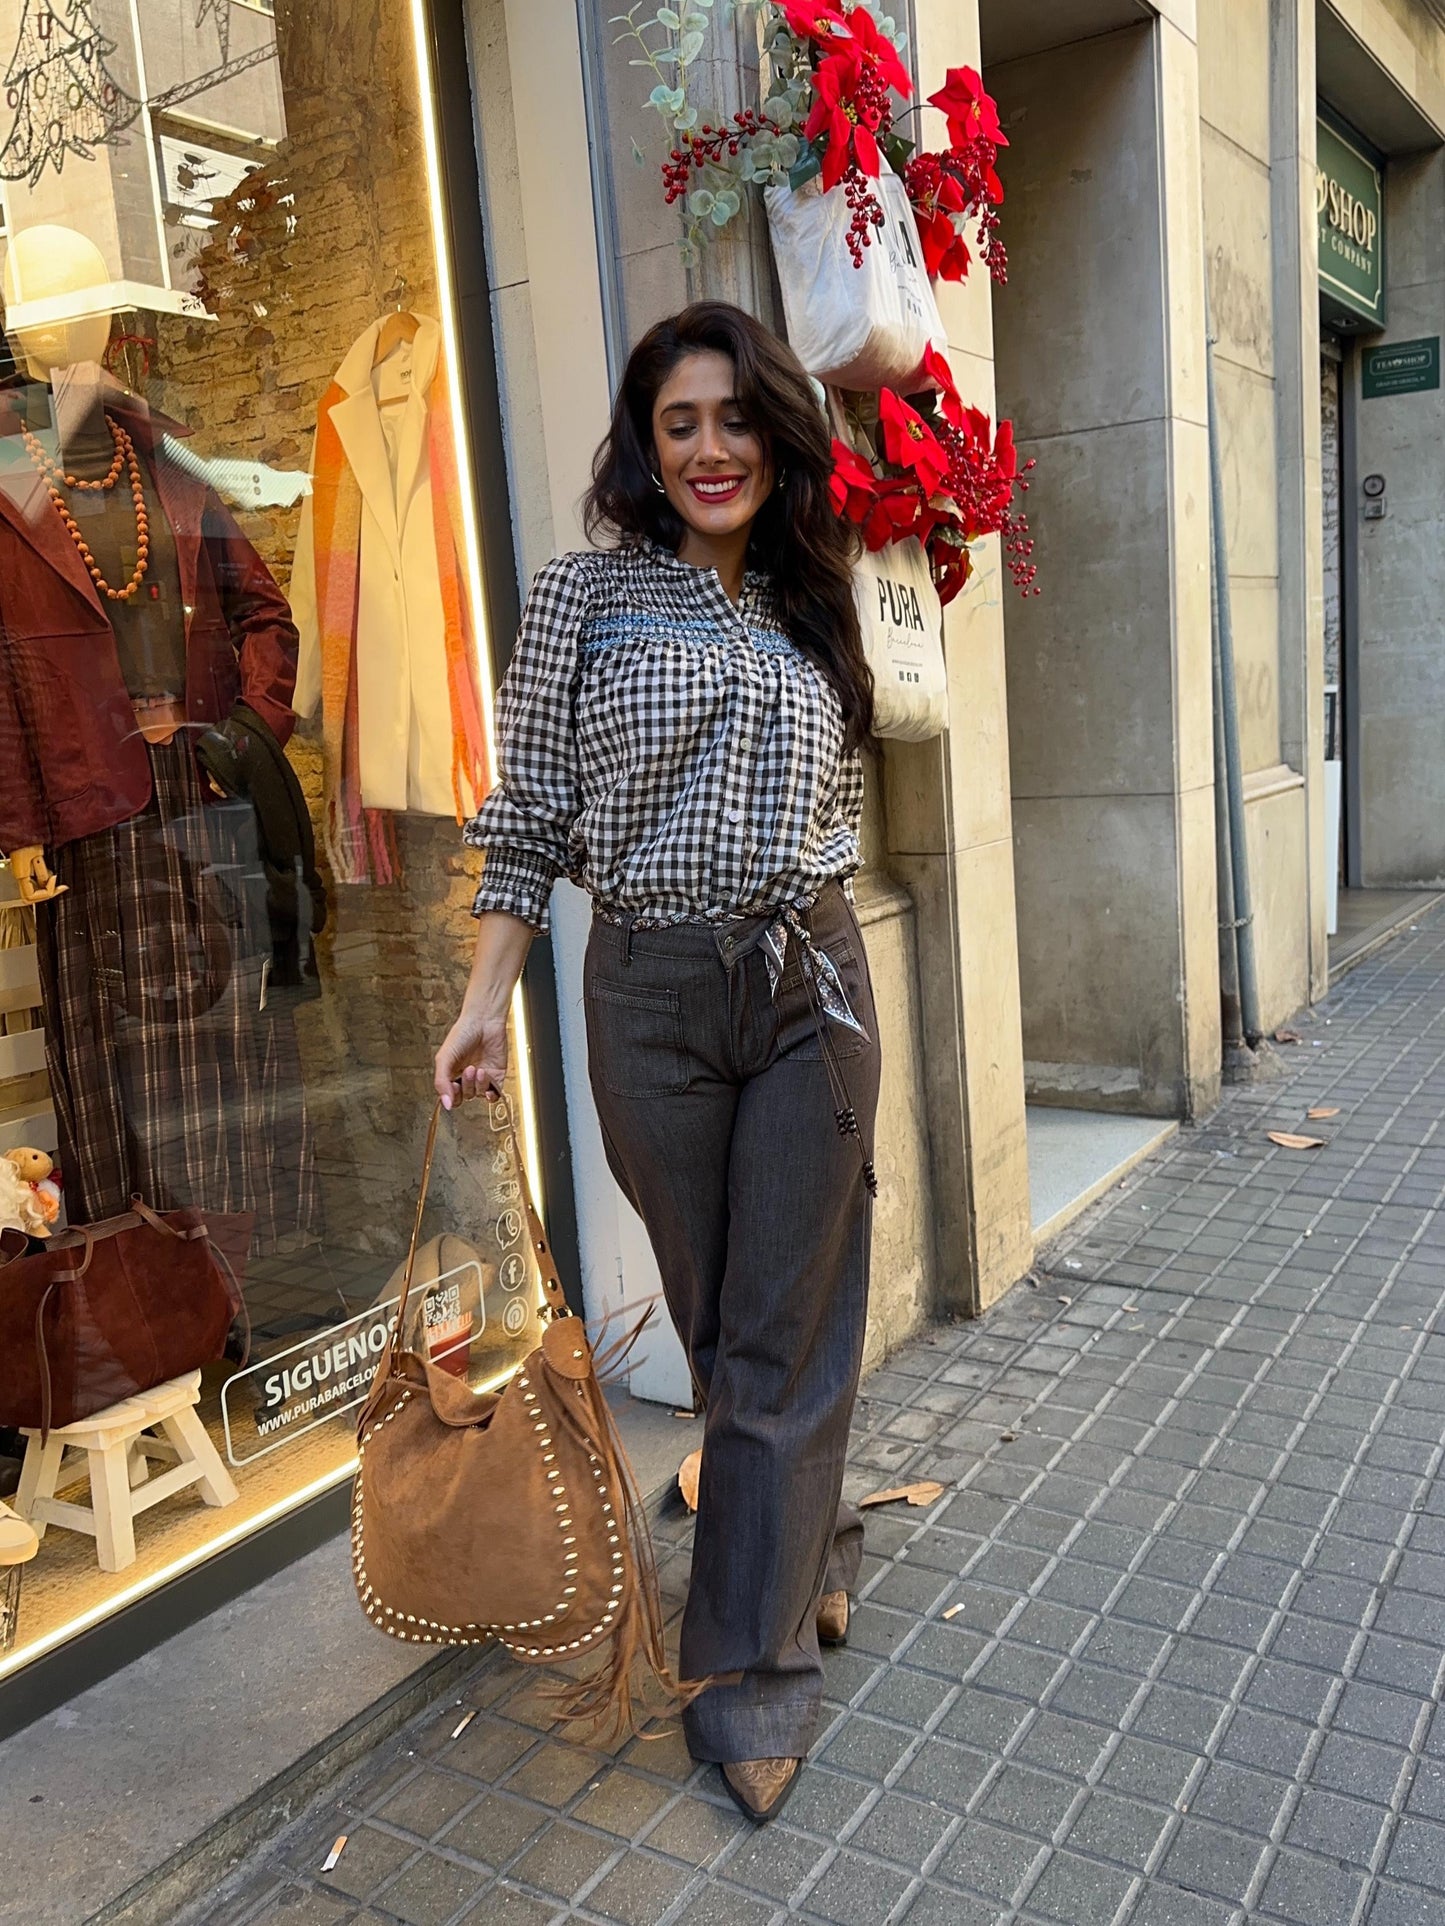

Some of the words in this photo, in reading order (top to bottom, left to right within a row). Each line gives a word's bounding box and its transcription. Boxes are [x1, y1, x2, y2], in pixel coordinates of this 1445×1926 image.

[1329, 179, 1376, 252] SHOP
[1331, 236, 1372, 275] COMPANY
[876, 576, 925, 632] PURA
